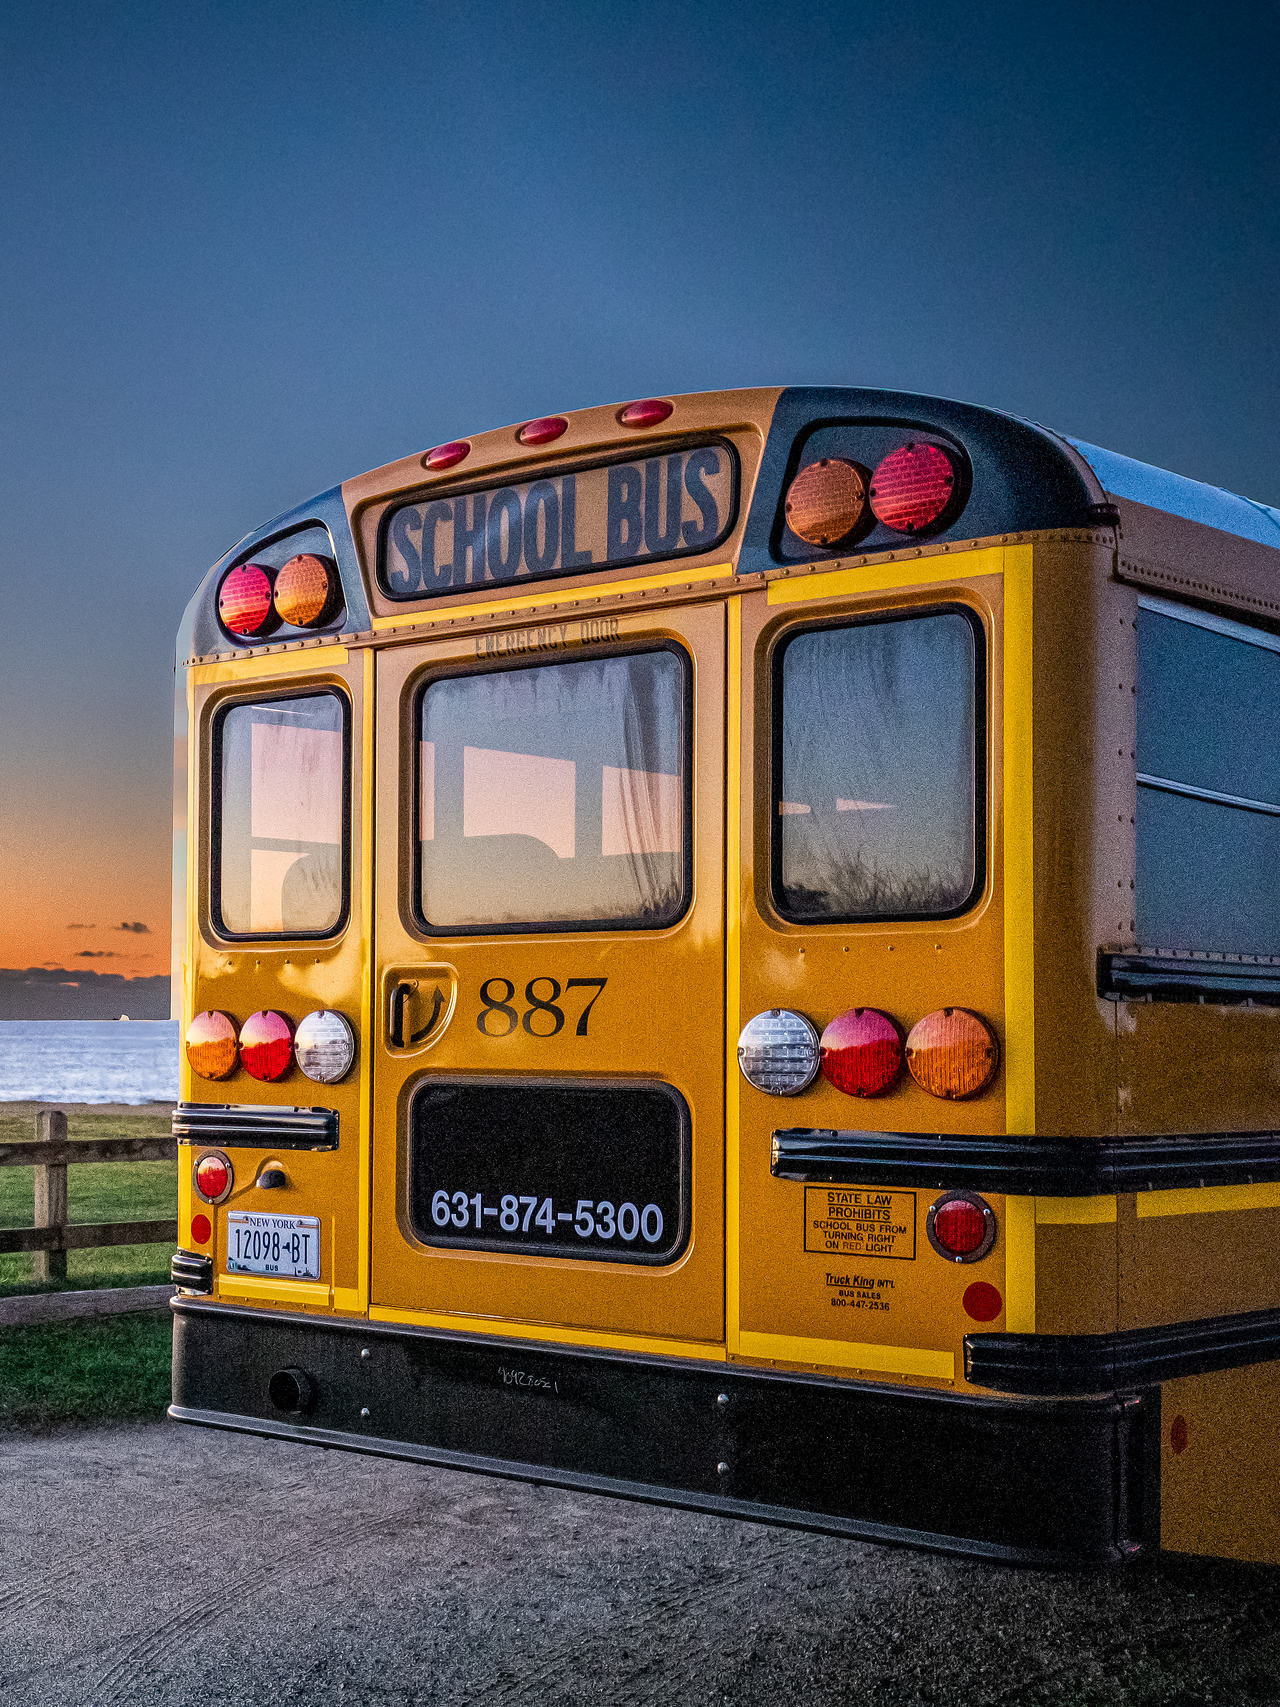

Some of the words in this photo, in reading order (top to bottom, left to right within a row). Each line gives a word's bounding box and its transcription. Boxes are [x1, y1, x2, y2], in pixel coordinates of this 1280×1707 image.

[391, 477, 592, 593] SCHOOL
[606, 449, 720, 560] BUS
[475, 624, 569, 660] EMERGENCY
[580, 618, 621, 645] DOOR
[476, 977, 609, 1037] 887
[827, 1191, 861, 1204] STATE
[867, 1194, 892, 1206] LAW
[431, 1189, 664, 1243] 631-874-5300
[828, 1206, 891, 1220] PROHIBITS
[249, 1217, 270, 1228] NEW
[272, 1219, 296, 1229] YORK
[812, 1220, 852, 1231] SCHOOL
[856, 1222, 875, 1232] BUS
[879, 1224, 907, 1234] FROM
[823, 1230, 864, 1241] TURNING
[867, 1233, 896, 1243] RIGHT
[235, 1228, 280, 1262] 12098
[825, 1240, 839, 1249] ON
[842, 1241, 861, 1251] RED
[865, 1243, 894, 1253] LIGHT
[265, 1264, 279, 1272] BUS
[825, 1272, 850, 1285] Truck
[853, 1275, 875, 1289] King
[839, 1289, 855, 1297] BUS
[857, 1291, 881, 1300] SALES
[831, 1298, 890, 1311] 800-447-2536
